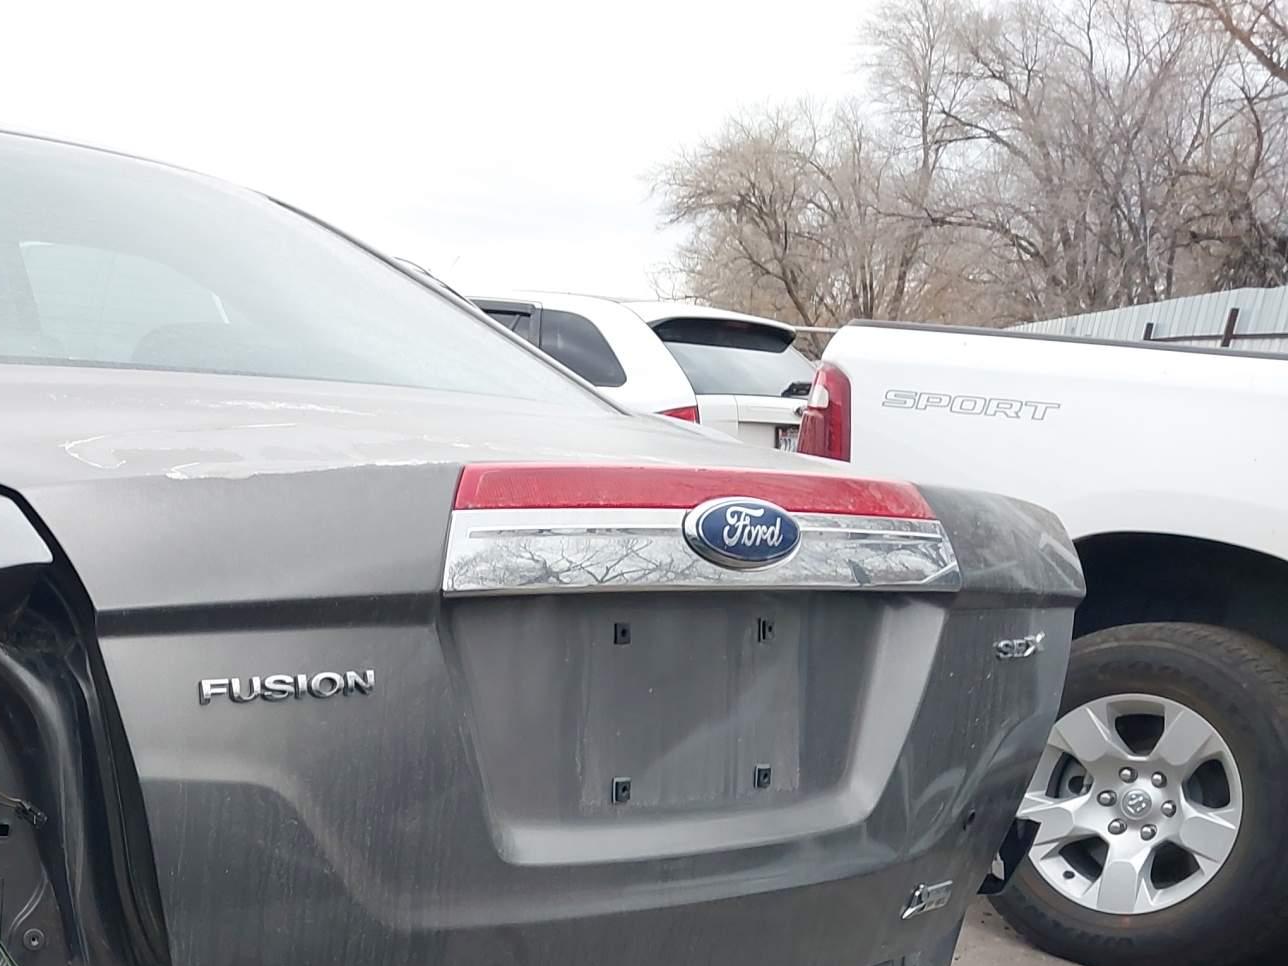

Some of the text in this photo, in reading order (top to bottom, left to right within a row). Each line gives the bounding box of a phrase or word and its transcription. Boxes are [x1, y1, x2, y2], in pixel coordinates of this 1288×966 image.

[881, 389, 1061, 421] SPORT
[723, 506, 783, 547] Ford
[199, 669, 375, 705] FUSION
